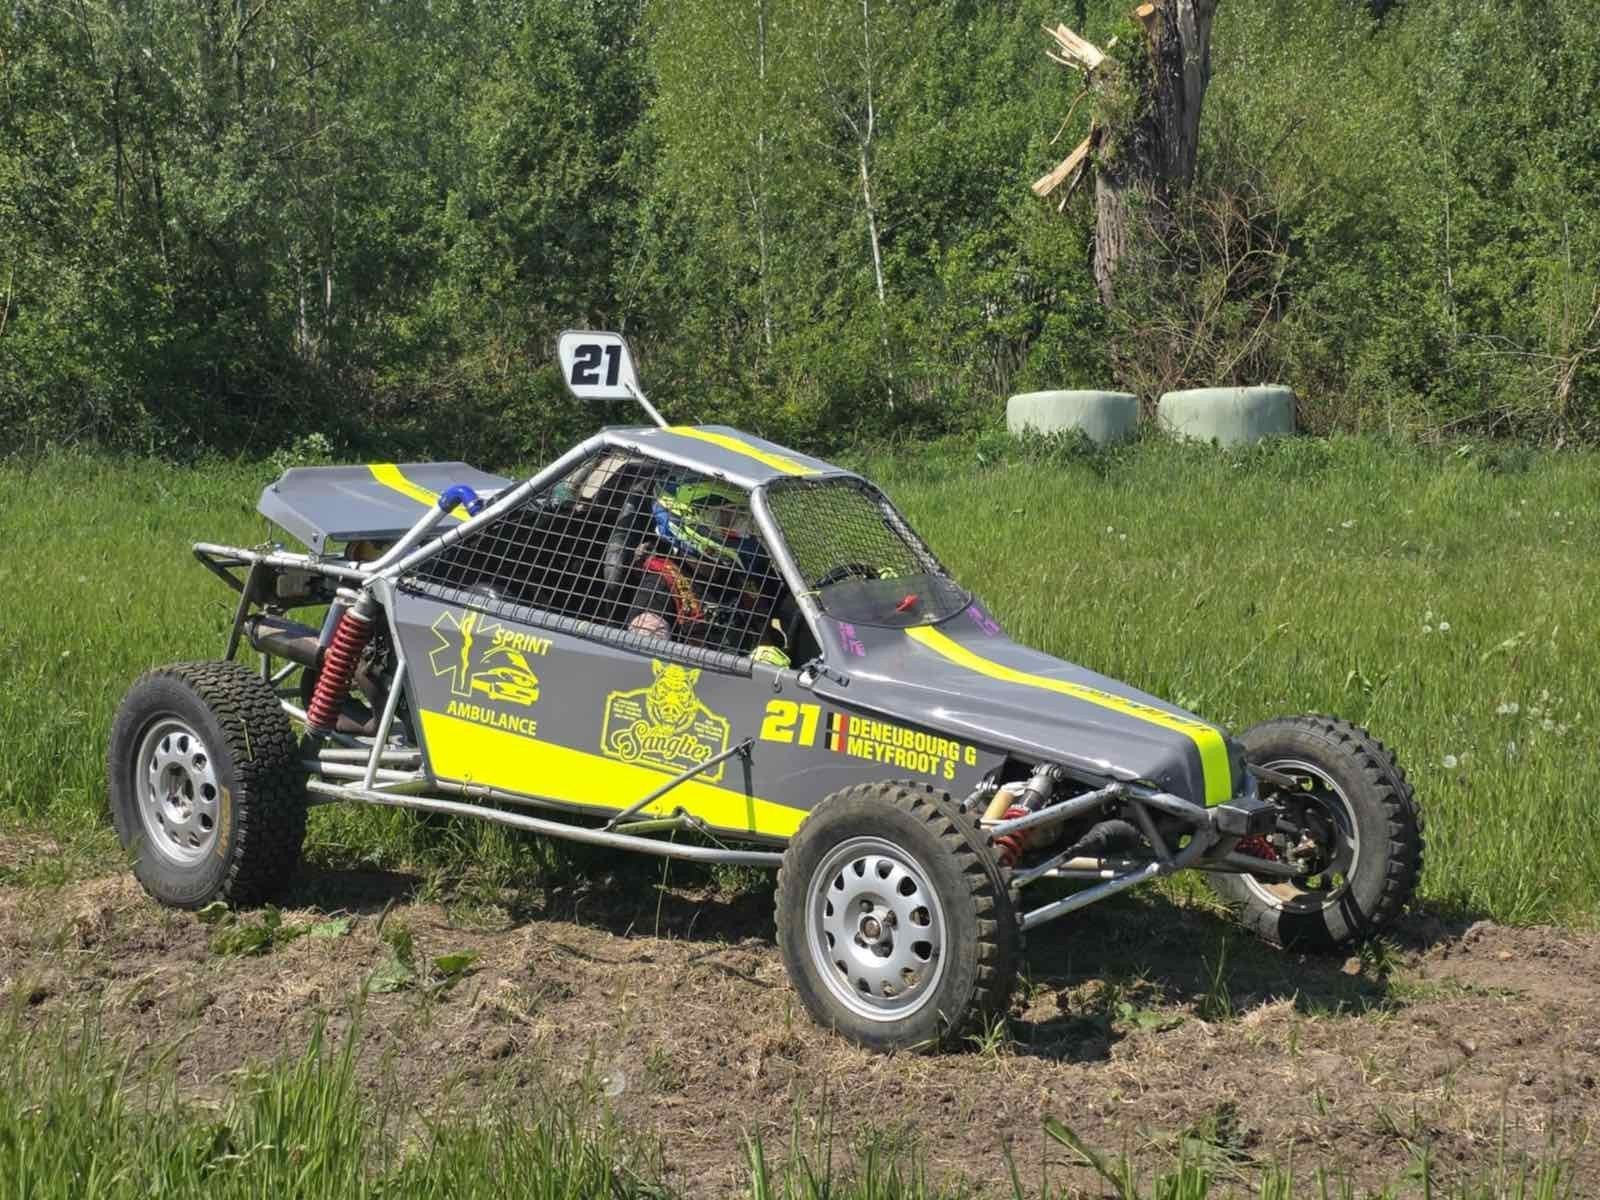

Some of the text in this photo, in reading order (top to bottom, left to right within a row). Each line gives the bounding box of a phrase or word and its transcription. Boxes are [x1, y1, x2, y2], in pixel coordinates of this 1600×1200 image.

[570, 344, 622, 386] 21
[491, 628, 553, 657] SPRINT
[446, 700, 538, 736] AMBULANCE
[759, 699, 822, 747] 21
[610, 720, 713, 764] Sanglier
[847, 738, 956, 780] MEYFROOT S
[849, 716, 977, 767] DENEUBOURG G
